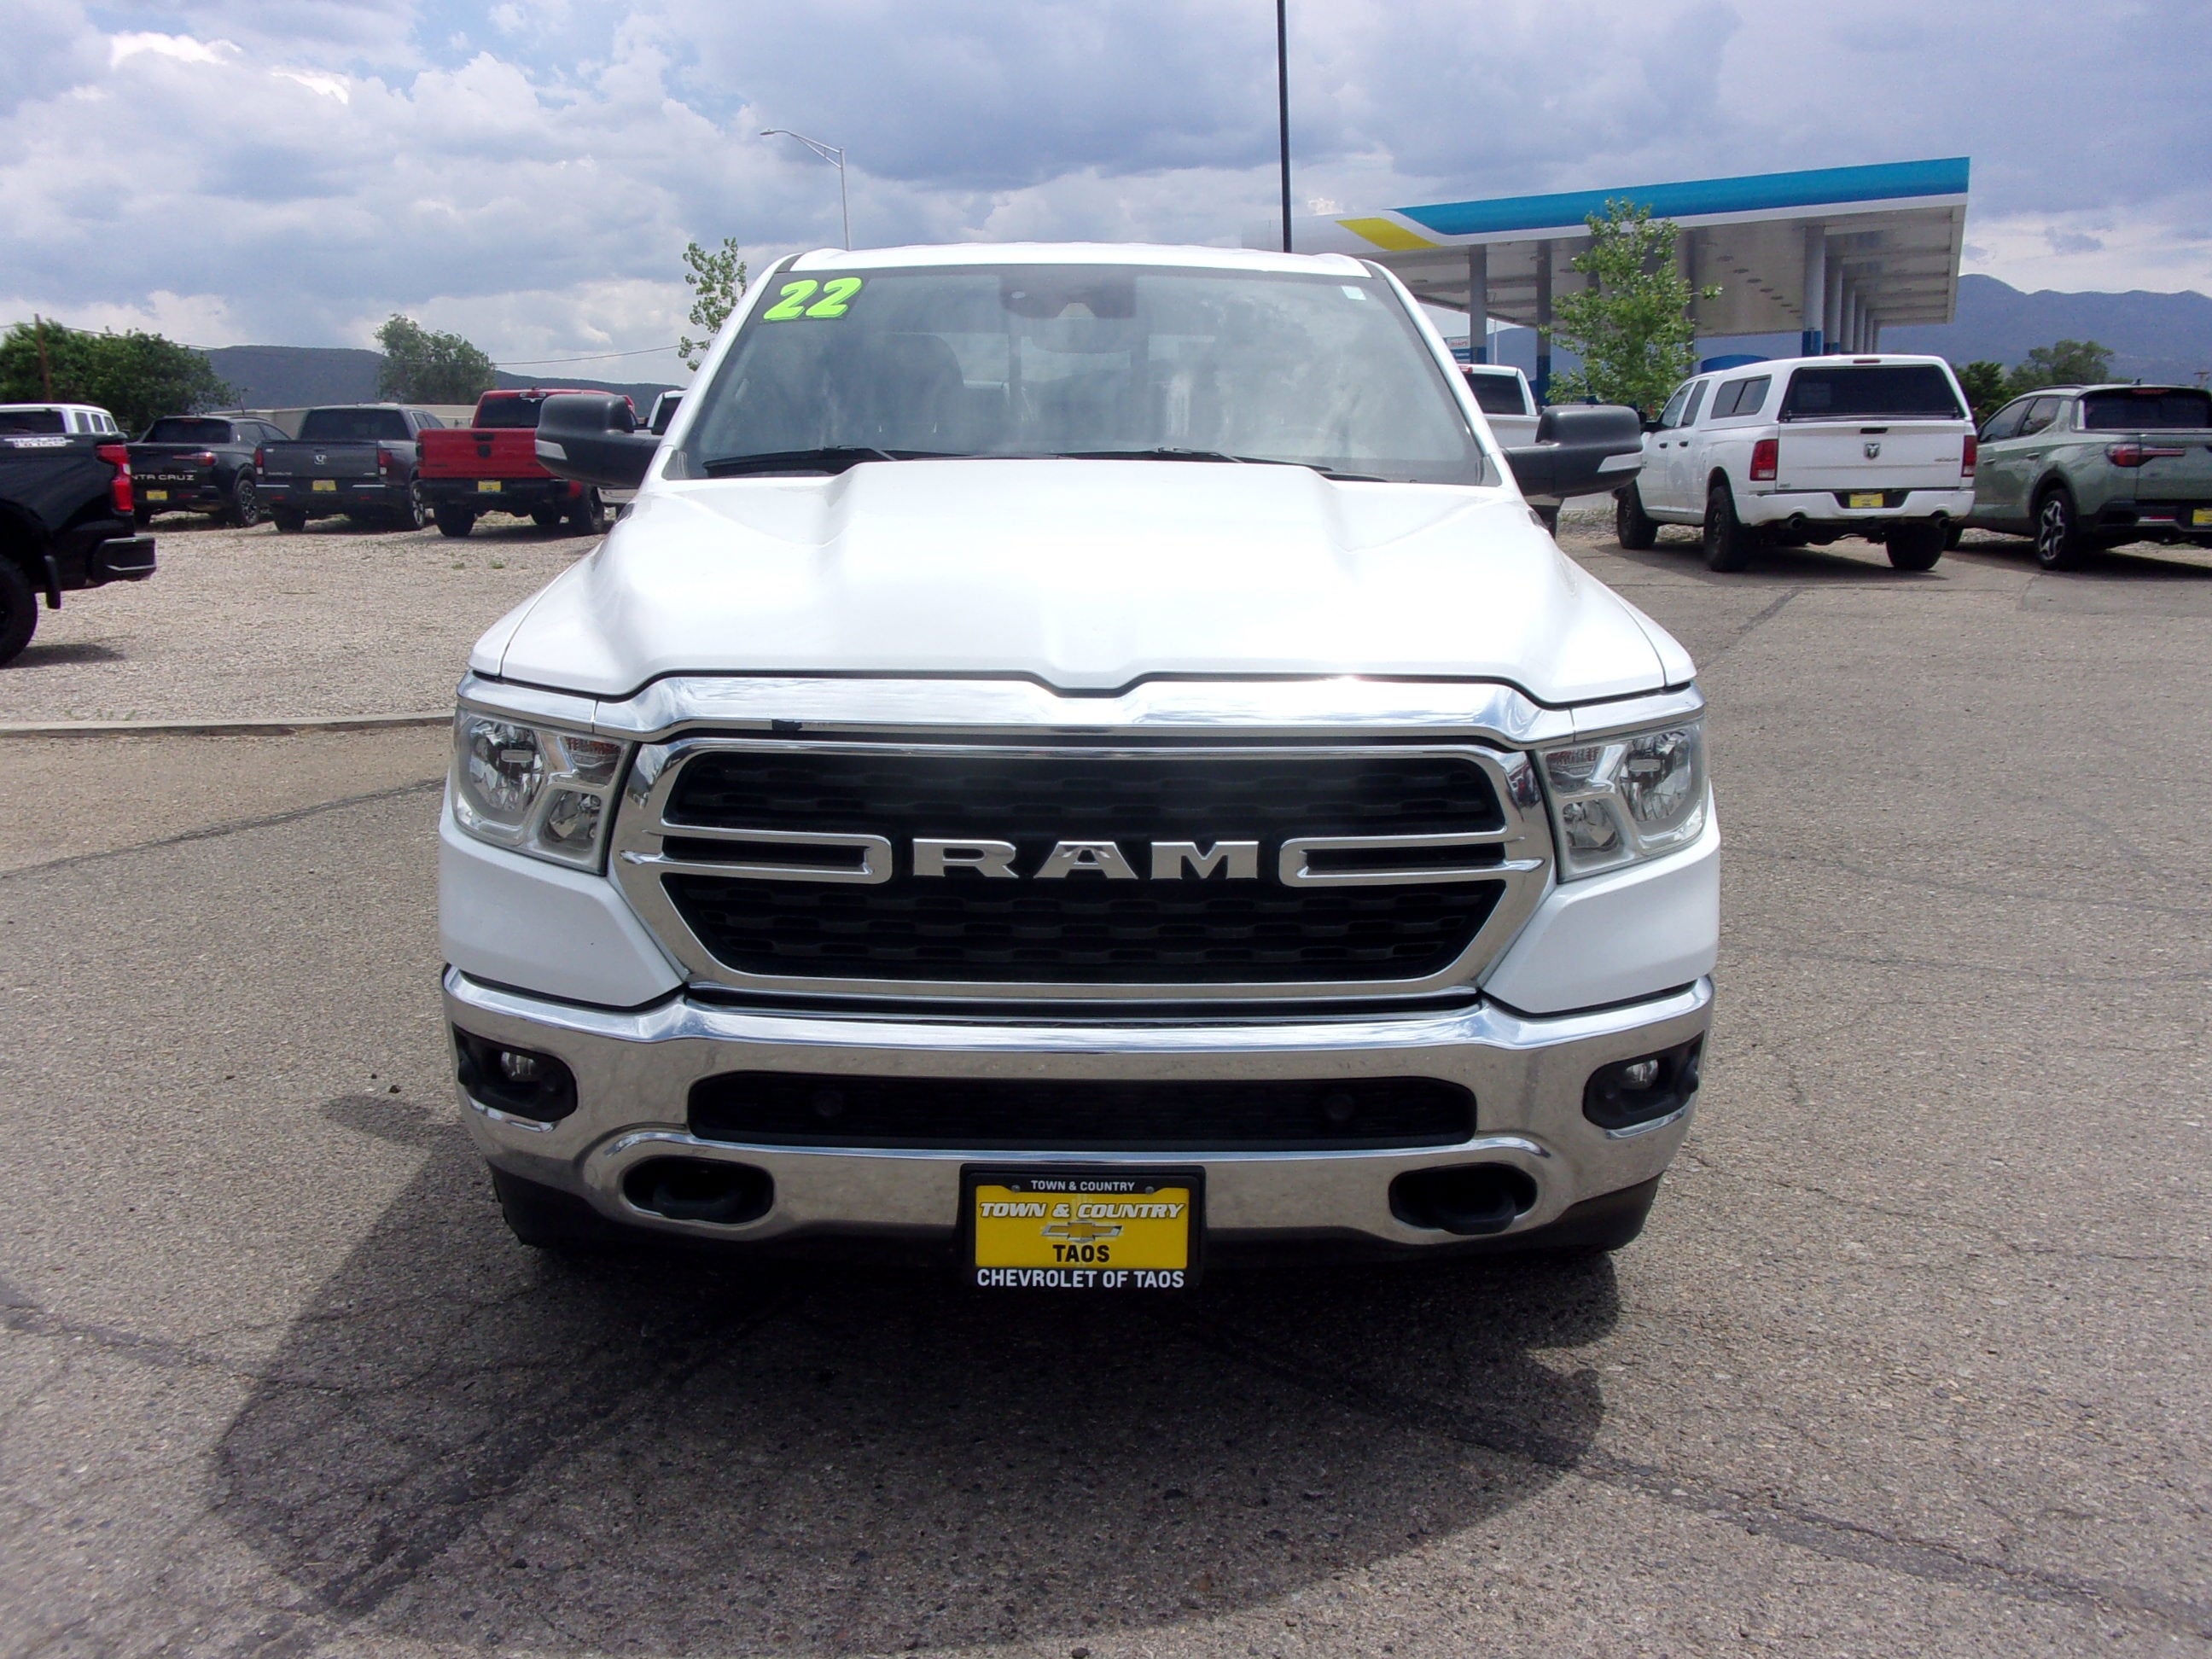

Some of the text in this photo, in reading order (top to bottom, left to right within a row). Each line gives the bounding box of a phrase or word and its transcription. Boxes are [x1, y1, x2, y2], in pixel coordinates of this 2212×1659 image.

[763, 277, 863, 321] 22
[913, 838, 1259, 880] RAM
[1031, 1179, 1135, 1192] TOWN & COUNTRY
[980, 1202, 1185, 1220] TOWN & COUNTRY
[1052, 1244, 1109, 1263] TAOS
[977, 1269, 1185, 1289] CHEVROLET OF TAOS
